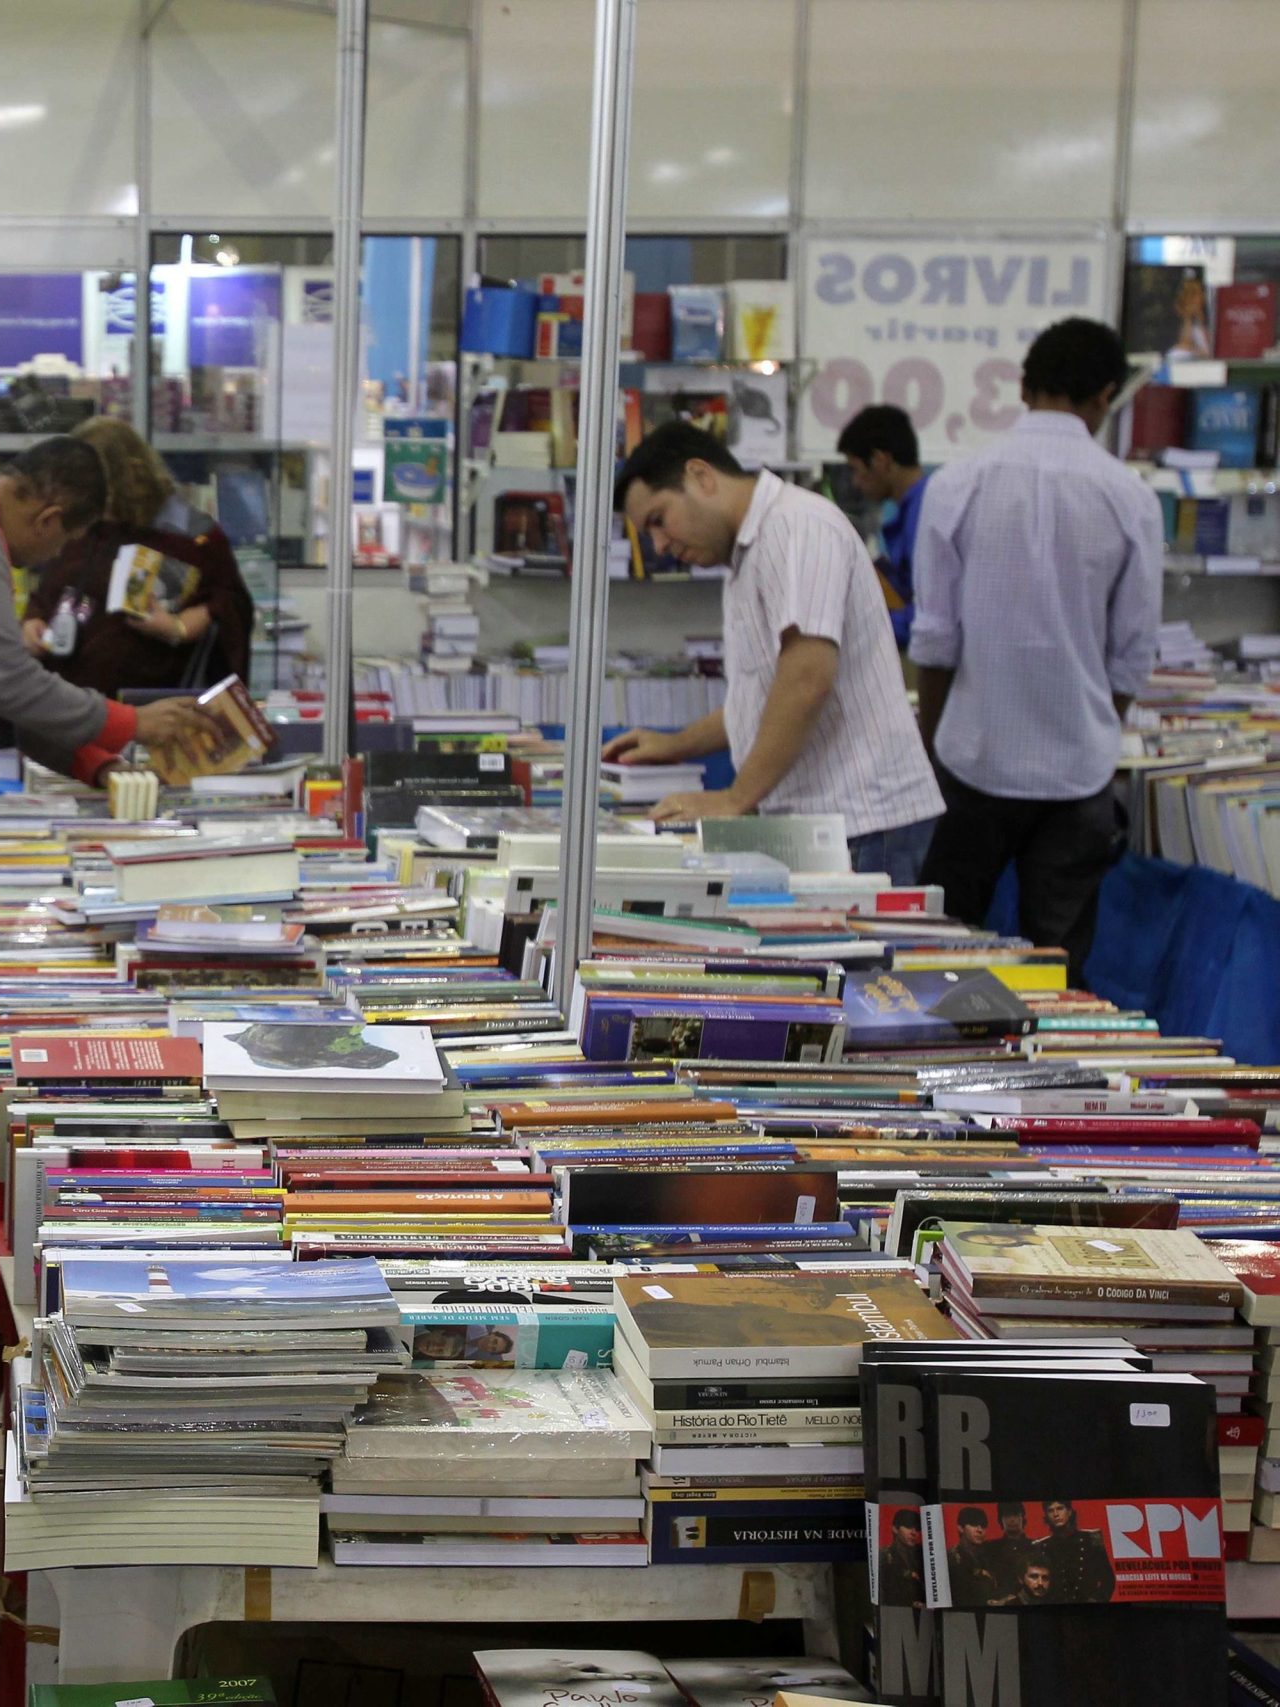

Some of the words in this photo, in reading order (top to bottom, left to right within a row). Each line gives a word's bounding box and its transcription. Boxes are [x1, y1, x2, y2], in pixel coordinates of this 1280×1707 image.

[735, 1165, 787, 1173] Making
[1097, 1287, 1104, 1297] O
[1106, 1286, 1134, 1298] CÓDIGO
[1135, 1289, 1147, 1299] DA
[1148, 1289, 1169, 1300] VINCI
[836, 1293, 905, 1341] Istambul
[692, 1358, 723, 1367] Pamuk
[725, 1358, 751, 1367] Orhan
[755, 1358, 790, 1367] Istambul
[673, 1414, 717, 1427] História
[719, 1414, 735, 1426] do
[737, 1413, 758, 1426] Rio
[760, 1413, 787, 1426] Tietê
[805, 1415, 839, 1425] MELLO
[877, 1384, 927, 1480] R
[938, 1394, 992, 1491] R
[925, 1511, 934, 1540] MINUTO
[1105, 1503, 1222, 1559] RPM
[733, 1529, 798, 1543] HISTÓRIA
[803, 1529, 823, 1540] NA
[927, 1540, 936, 1556] POR
[942, 1613, 1021, 1707] M
[218, 1678, 257, 1688] 2007
[542, 1688, 640, 1706] Paulo
